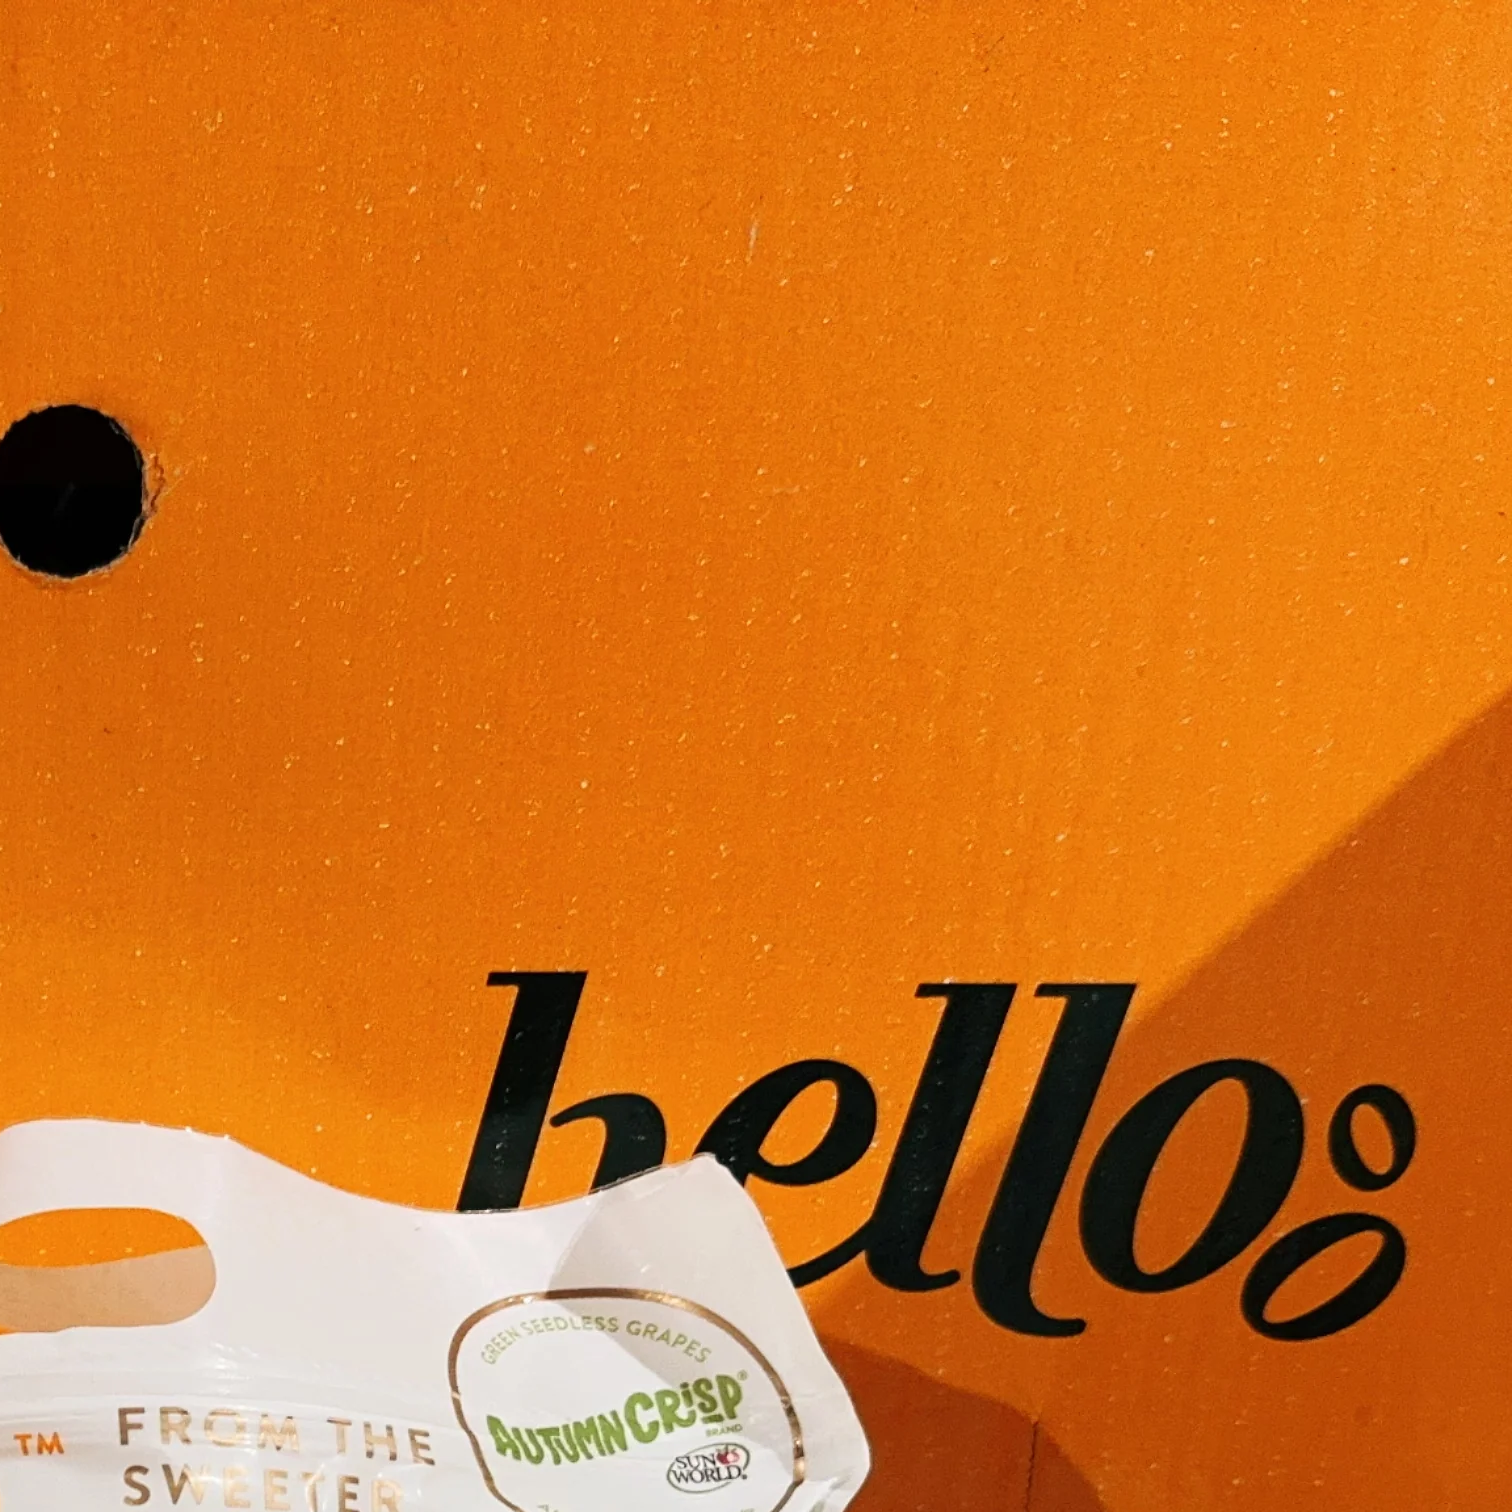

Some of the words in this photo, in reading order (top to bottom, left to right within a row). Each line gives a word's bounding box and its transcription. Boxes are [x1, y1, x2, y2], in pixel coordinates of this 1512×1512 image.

[481, 1327, 521, 1366] GREEN
[520, 1315, 620, 1337] SEEDLESS
[625, 1319, 713, 1364] GRAPES
[117, 1405, 301, 1453] FROM
[326, 1416, 435, 1466] THE
[705, 1423, 743, 1437] BRAND
[675, 1453, 716, 1470] SUN
